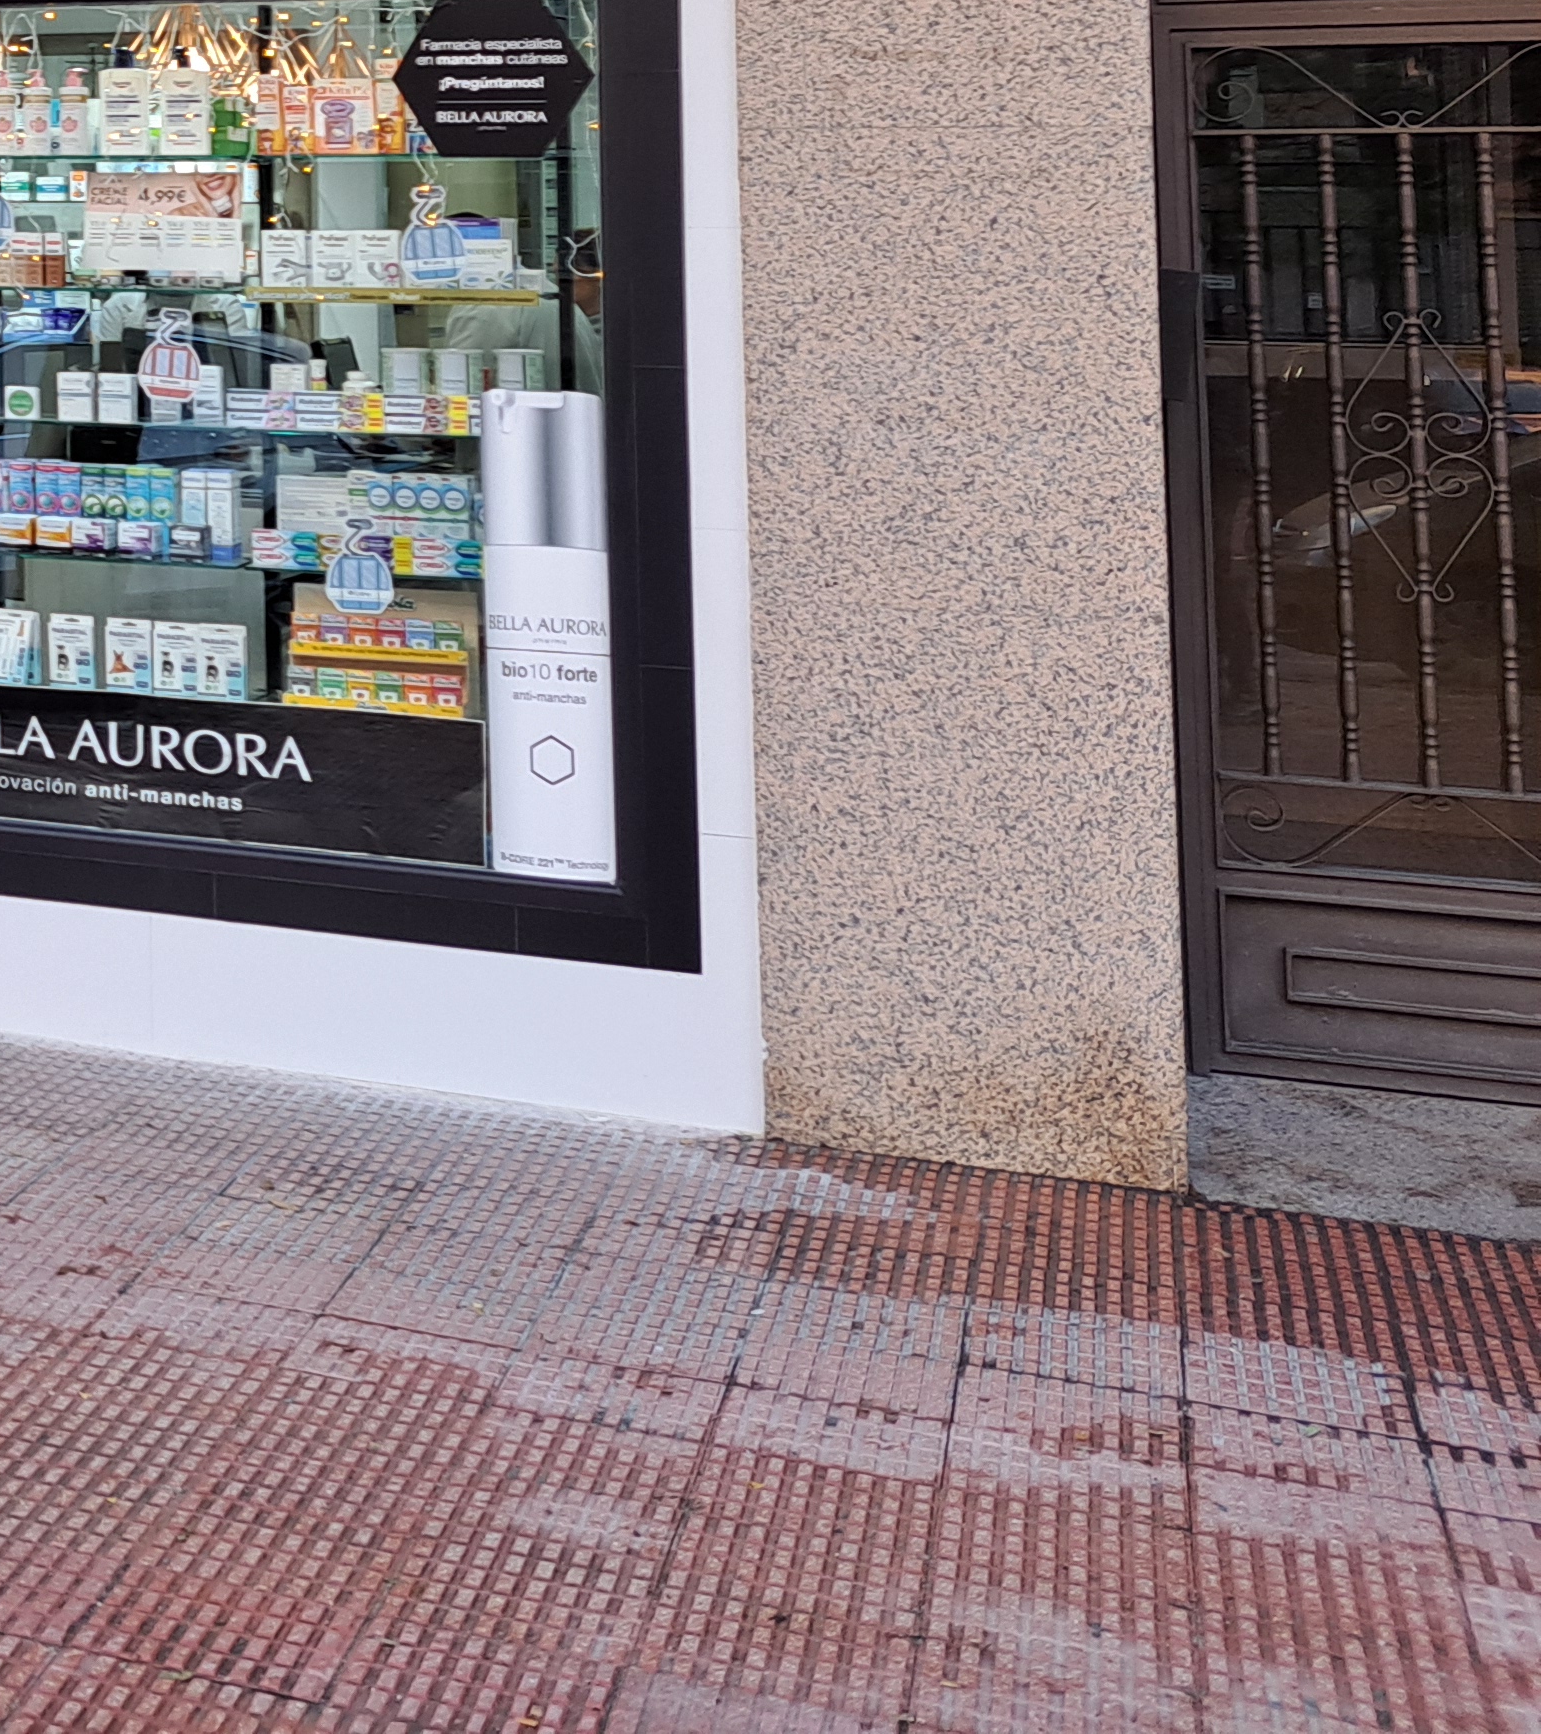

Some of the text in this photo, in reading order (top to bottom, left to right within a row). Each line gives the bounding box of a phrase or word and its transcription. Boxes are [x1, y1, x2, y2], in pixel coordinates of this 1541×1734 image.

[420, 38, 562, 53] Farmacia especialista
[415, 53, 568, 65] en manchas cutáneas
[435, 111, 548, 124] BELLA AURORA
[138, 187, 187, 206] 4,99€
[488, 614, 607, 637] BELLA AURORA
[501, 661, 598, 683] bio10 forte
[512, 691, 587, 705] anti-manchas
[67, 719, 315, 782] AURORA
[84, 782, 243, 812] anti-manchas
